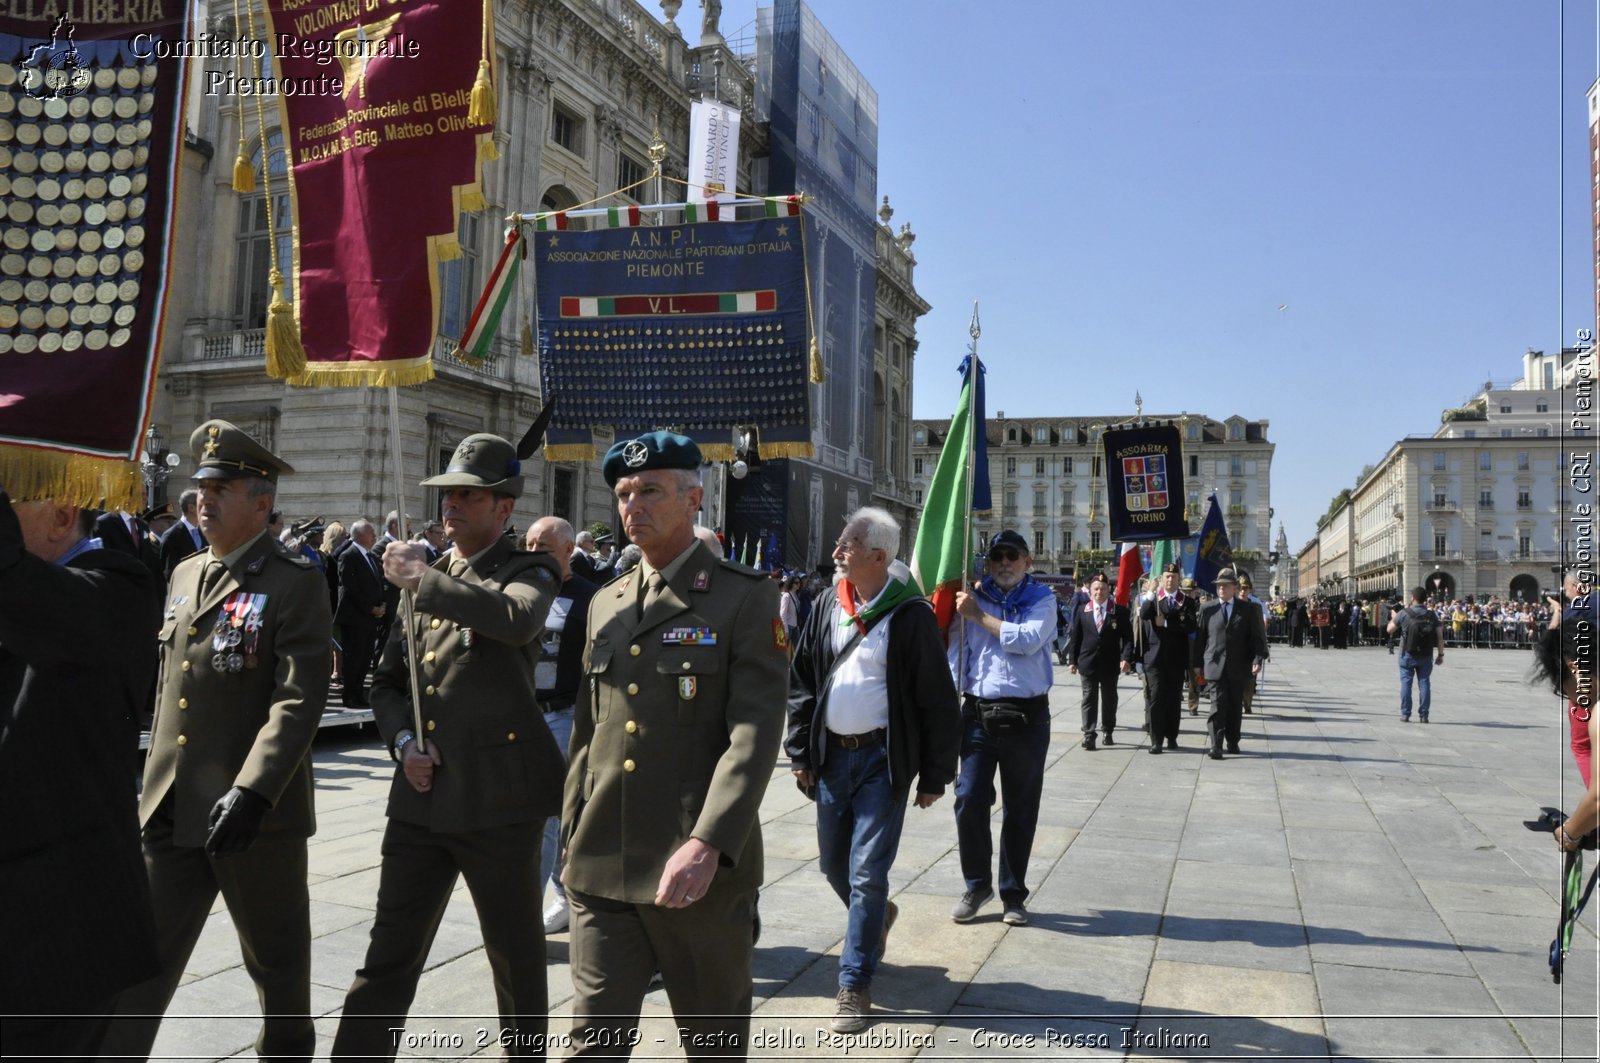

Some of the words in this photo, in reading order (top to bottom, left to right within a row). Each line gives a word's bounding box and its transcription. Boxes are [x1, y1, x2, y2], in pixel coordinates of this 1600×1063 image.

[294, 0, 361, 37] VOLONTARI
[347, 99, 410, 124] Provinciale
[413, 95, 428, 113] di
[431, 89, 471, 110] Biella
[354, 129, 382, 148] Brig.
[384, 119, 434, 141] Matteo
[704, 107, 719, 178] LEONARDO
[720, 124, 730, 160] VINCI
[718, 165, 727, 182] DA
[630, 228, 701, 247] A.N.P.I.
[547, 249, 621, 263] ASSOCIAZIONE
[623, 248, 682, 260] NAZIONALE
[685, 244, 744, 258] PARTIGIANI
[747, 241, 792, 255] D'ITALIA
[626, 262, 704, 278] PIEMONTE
[648, 297, 662, 315] V.
[669, 297, 686, 314] L.
[1116, 444, 1169, 459] ASSOARMA
[1130, 512, 1166, 523] TORINO
